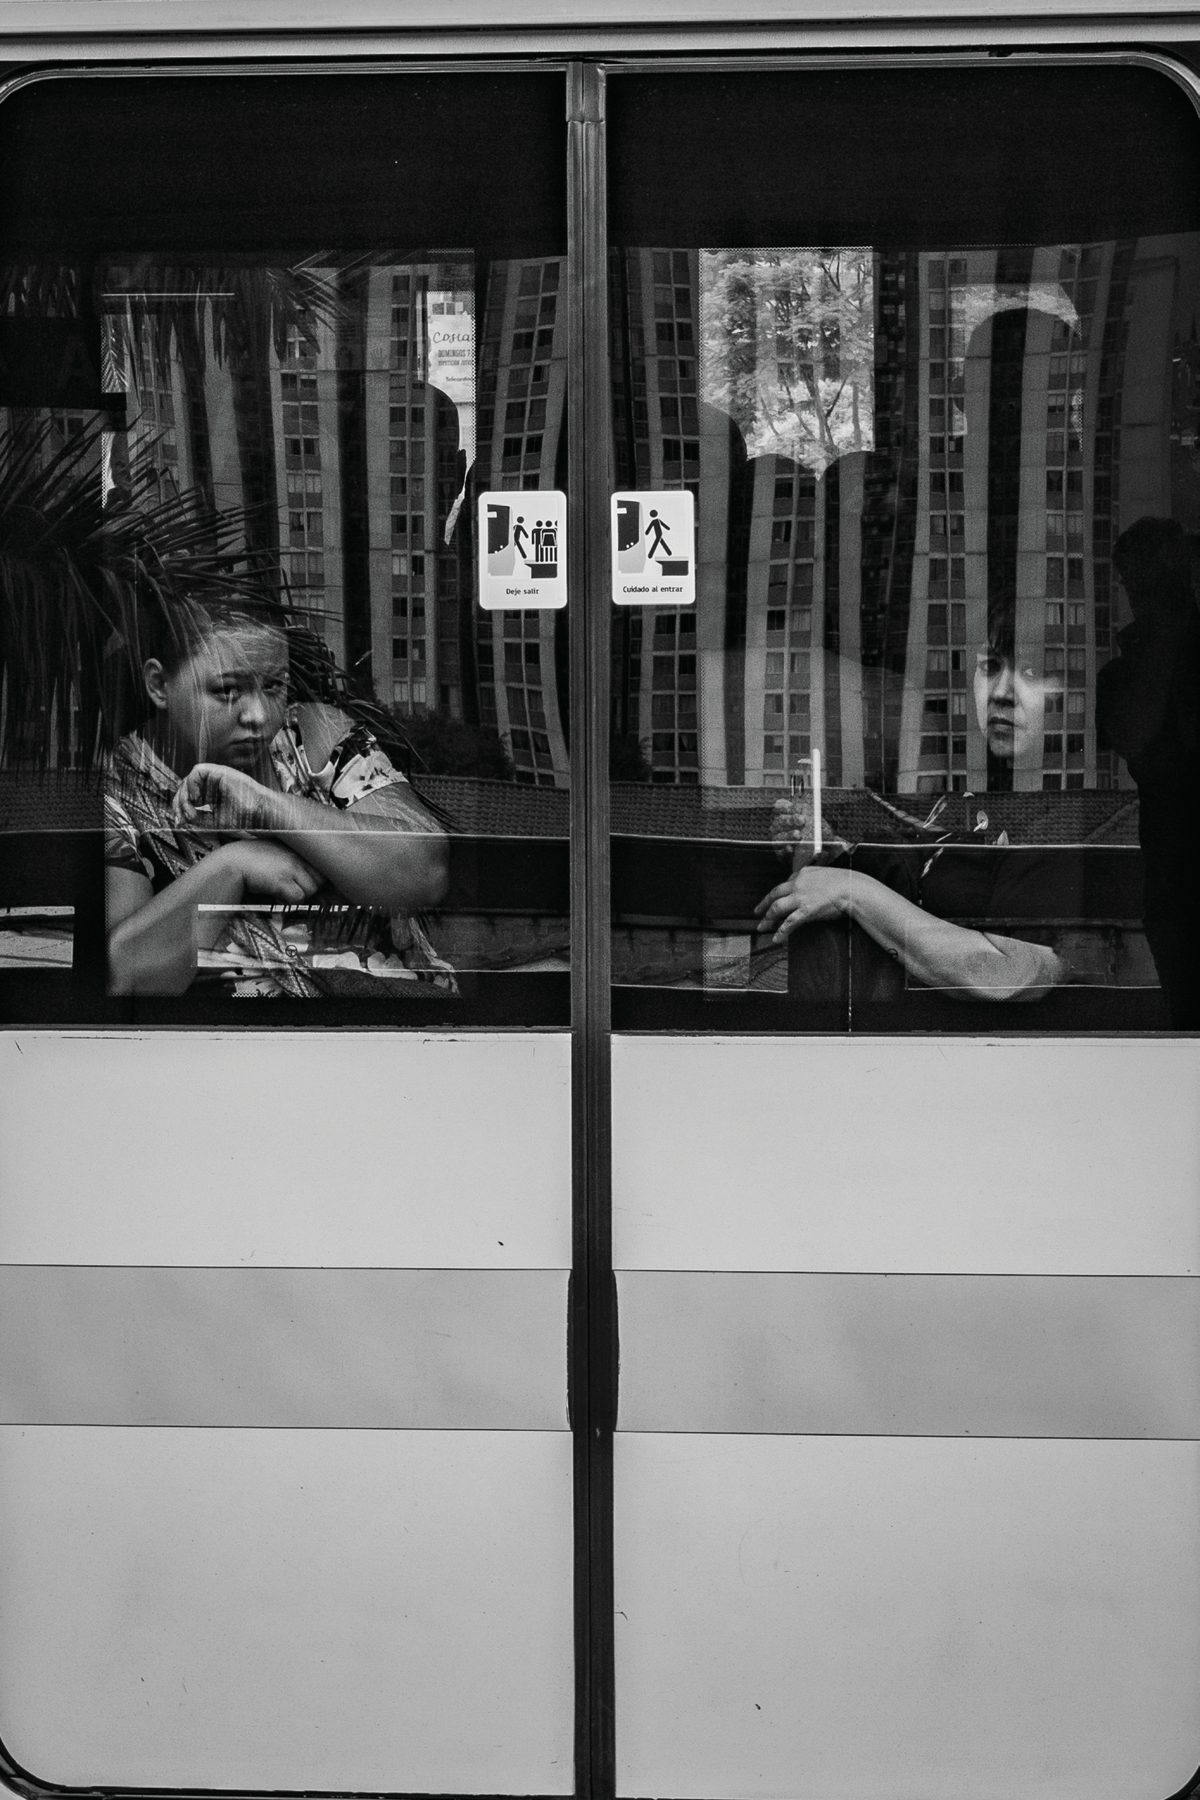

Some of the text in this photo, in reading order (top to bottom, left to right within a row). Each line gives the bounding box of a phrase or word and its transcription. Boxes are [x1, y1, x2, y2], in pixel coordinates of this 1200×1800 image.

[505, 586, 540, 597] Deje salir
[622, 585, 685, 593] Cuidado al entrar
